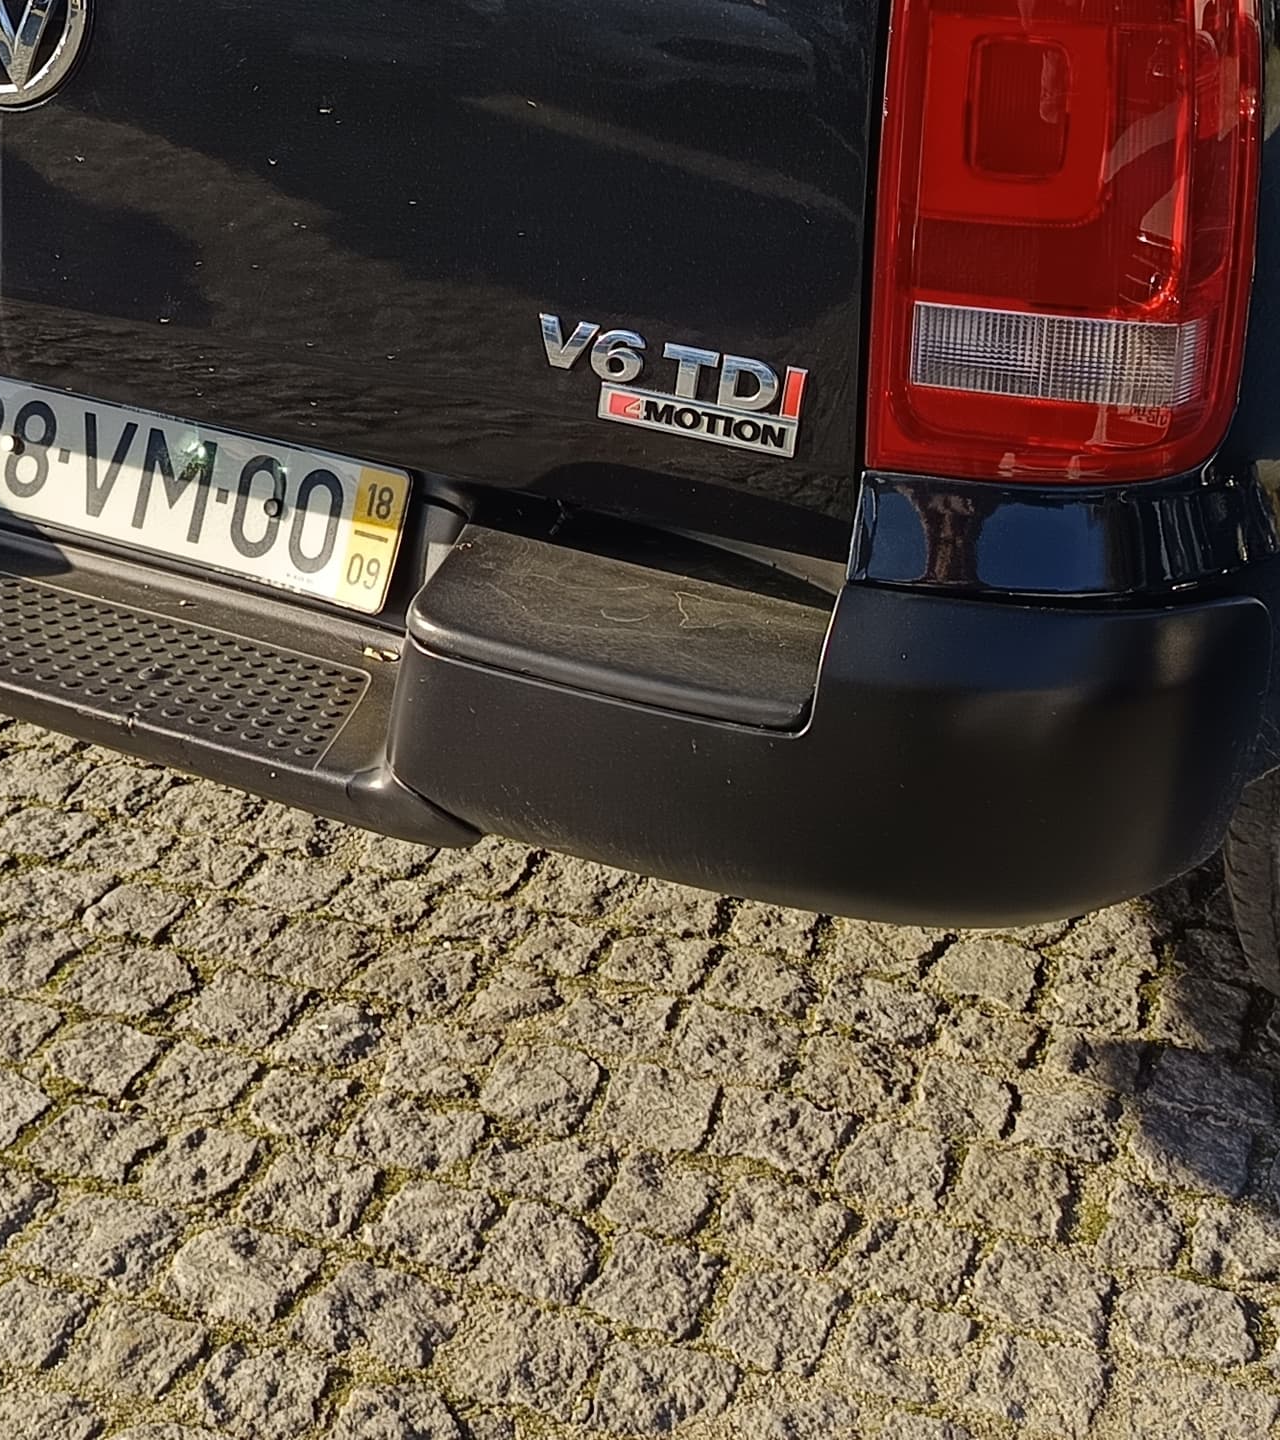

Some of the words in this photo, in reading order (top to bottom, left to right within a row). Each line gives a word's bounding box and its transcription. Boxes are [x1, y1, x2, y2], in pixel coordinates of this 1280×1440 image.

[537, 311, 648, 384] V6
[662, 341, 810, 421] TDI
[365, 482, 396, 521] 18
[345, 552, 382, 591] 09
